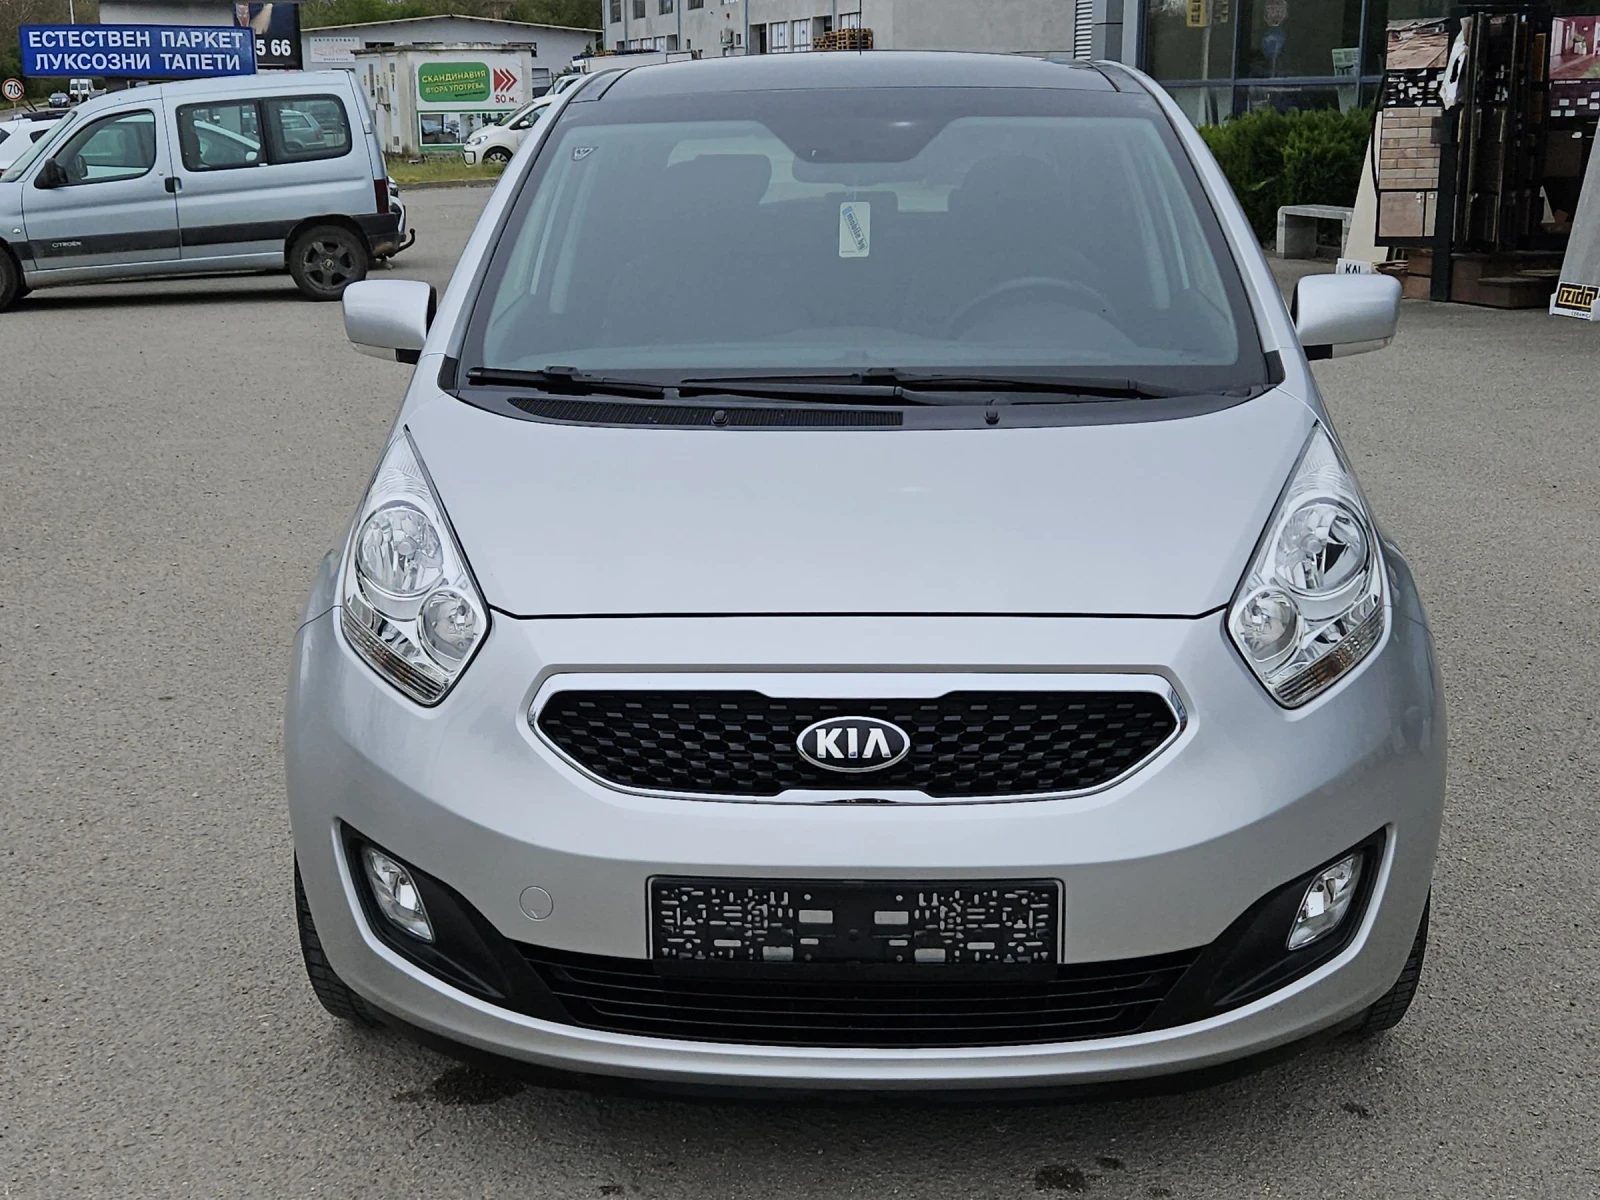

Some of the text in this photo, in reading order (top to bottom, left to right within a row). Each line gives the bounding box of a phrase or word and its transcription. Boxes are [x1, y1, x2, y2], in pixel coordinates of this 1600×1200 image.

[28, 30, 244, 48] ЕСТЕСТВЕН ПАРКЕТ
[270, 39, 291, 56] 66
[35, 53, 241, 71] ЛУКСОЗНИ ТАПЕТИ
[421, 70, 486, 83] СКАНДИНАВИЯ
[7, 84, 19, 95] 70
[425, 85, 448, 94] ВТОРА
[449, 82, 486, 92] УПОТРЕБА
[495, 95, 507, 103] 50
[815, 727, 892, 759] KIA
